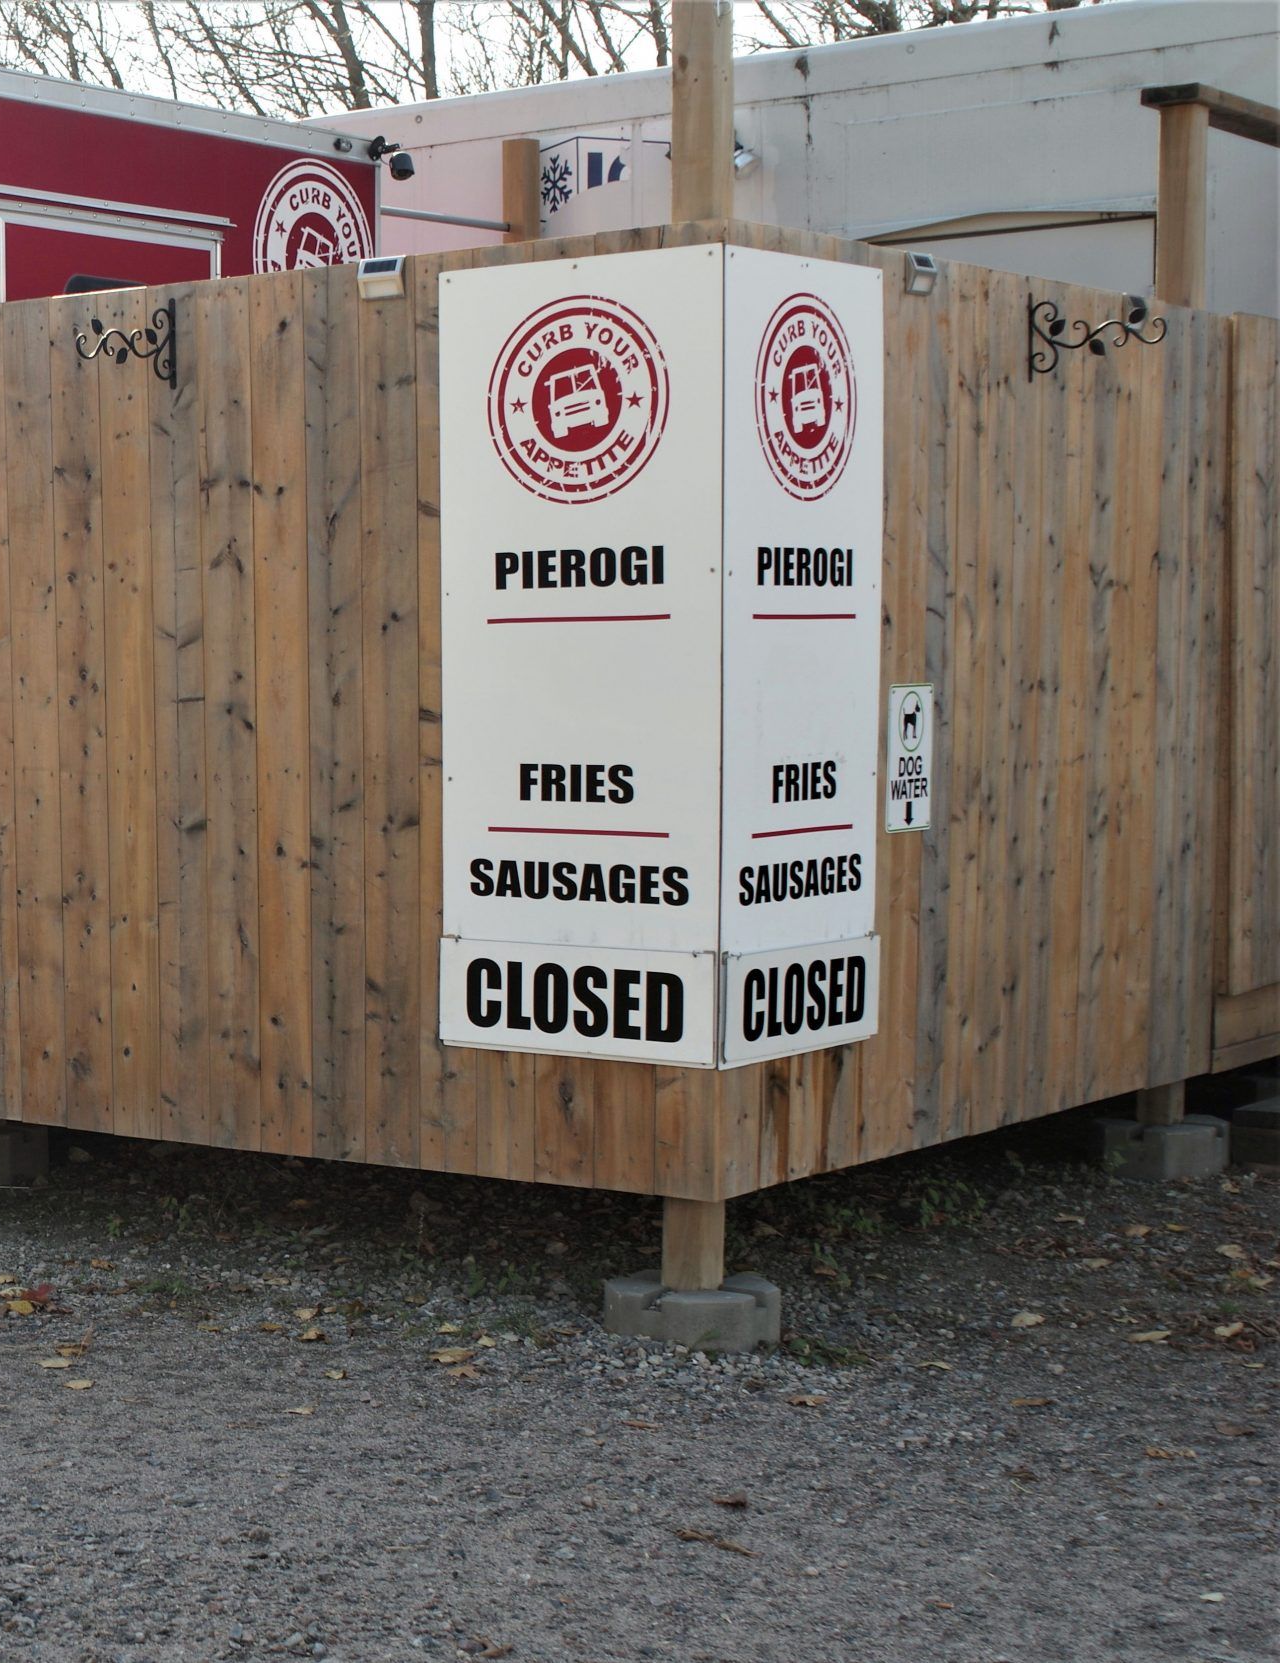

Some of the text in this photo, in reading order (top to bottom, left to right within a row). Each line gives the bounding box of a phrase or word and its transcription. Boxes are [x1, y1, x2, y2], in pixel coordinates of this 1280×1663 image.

[289, 187, 358, 261] CURB YOU
[517, 321, 641, 379] CURB YOUR
[772, 320, 843, 380] CURB YOUR
[519, 428, 635, 479] APPETITE
[773, 430, 840, 475] APPETITE
[495, 545, 665, 590] PIEROGI
[757, 547, 853, 587] PIEROGI
[519, 763, 635, 804] FRIES
[772, 760, 837, 803] FRIES
[891, 778, 929, 801] WATER
[898, 755, 923, 778] DOG
[469, 857, 690, 906] SAUSAGES
[738, 853, 863, 907] SAUSAGES
[466, 957, 685, 1043] CLOSED
[743, 955, 866, 1042] CLOSED
